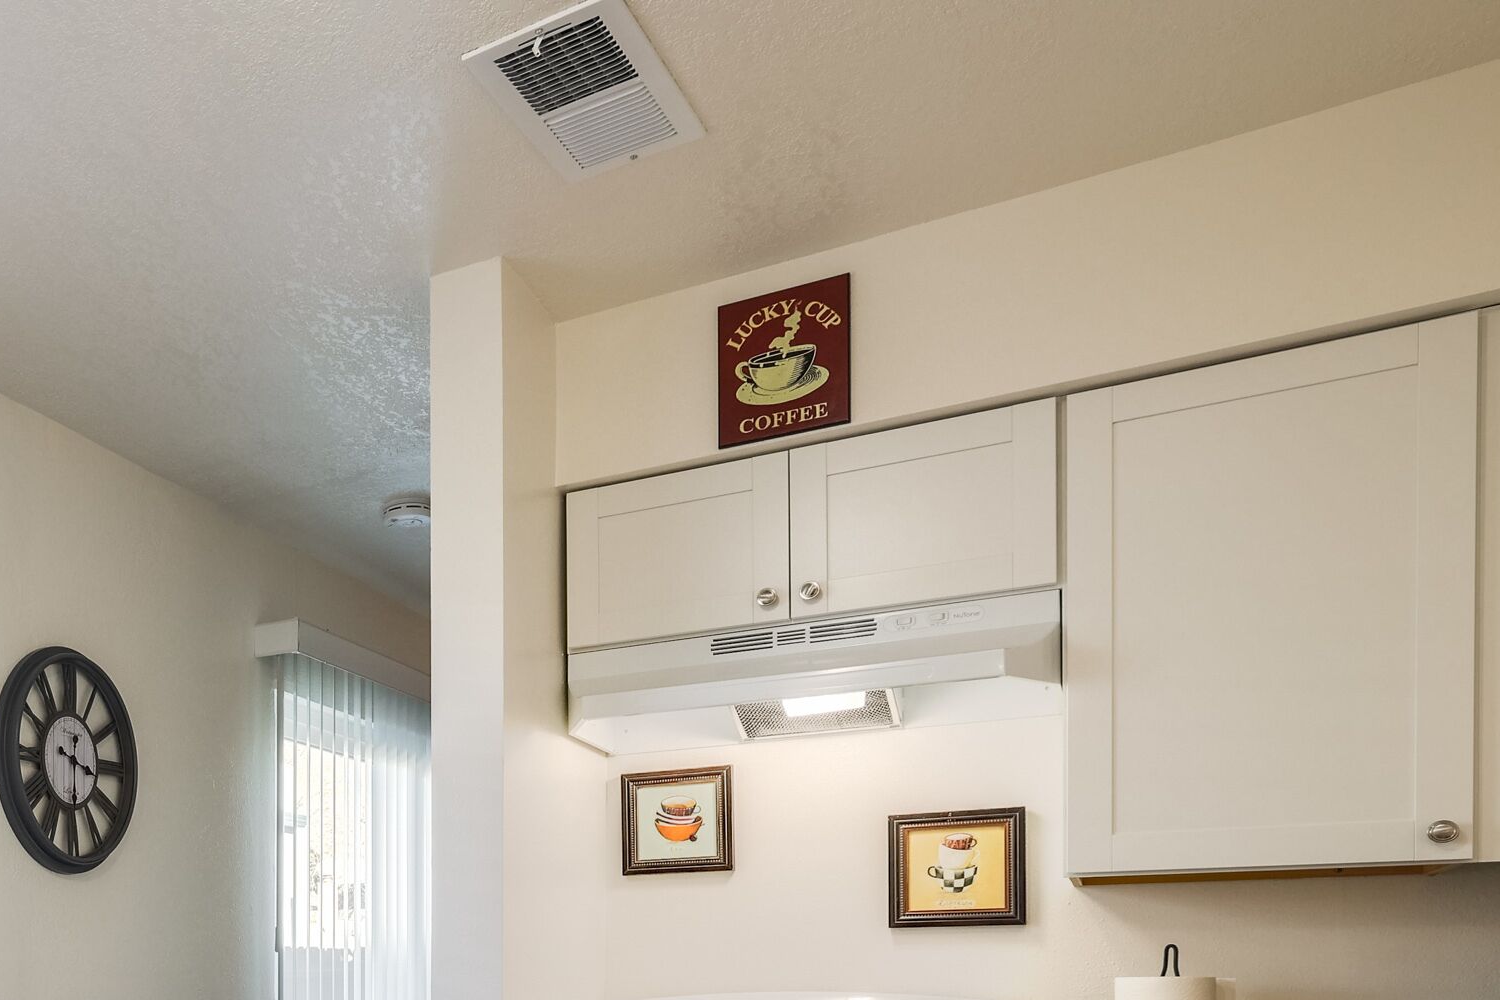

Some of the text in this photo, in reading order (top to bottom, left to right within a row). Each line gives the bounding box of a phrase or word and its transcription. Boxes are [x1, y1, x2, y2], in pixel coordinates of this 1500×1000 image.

[726, 299, 842, 351] LUCKY CUP
[739, 402, 829, 434] COFFEE
